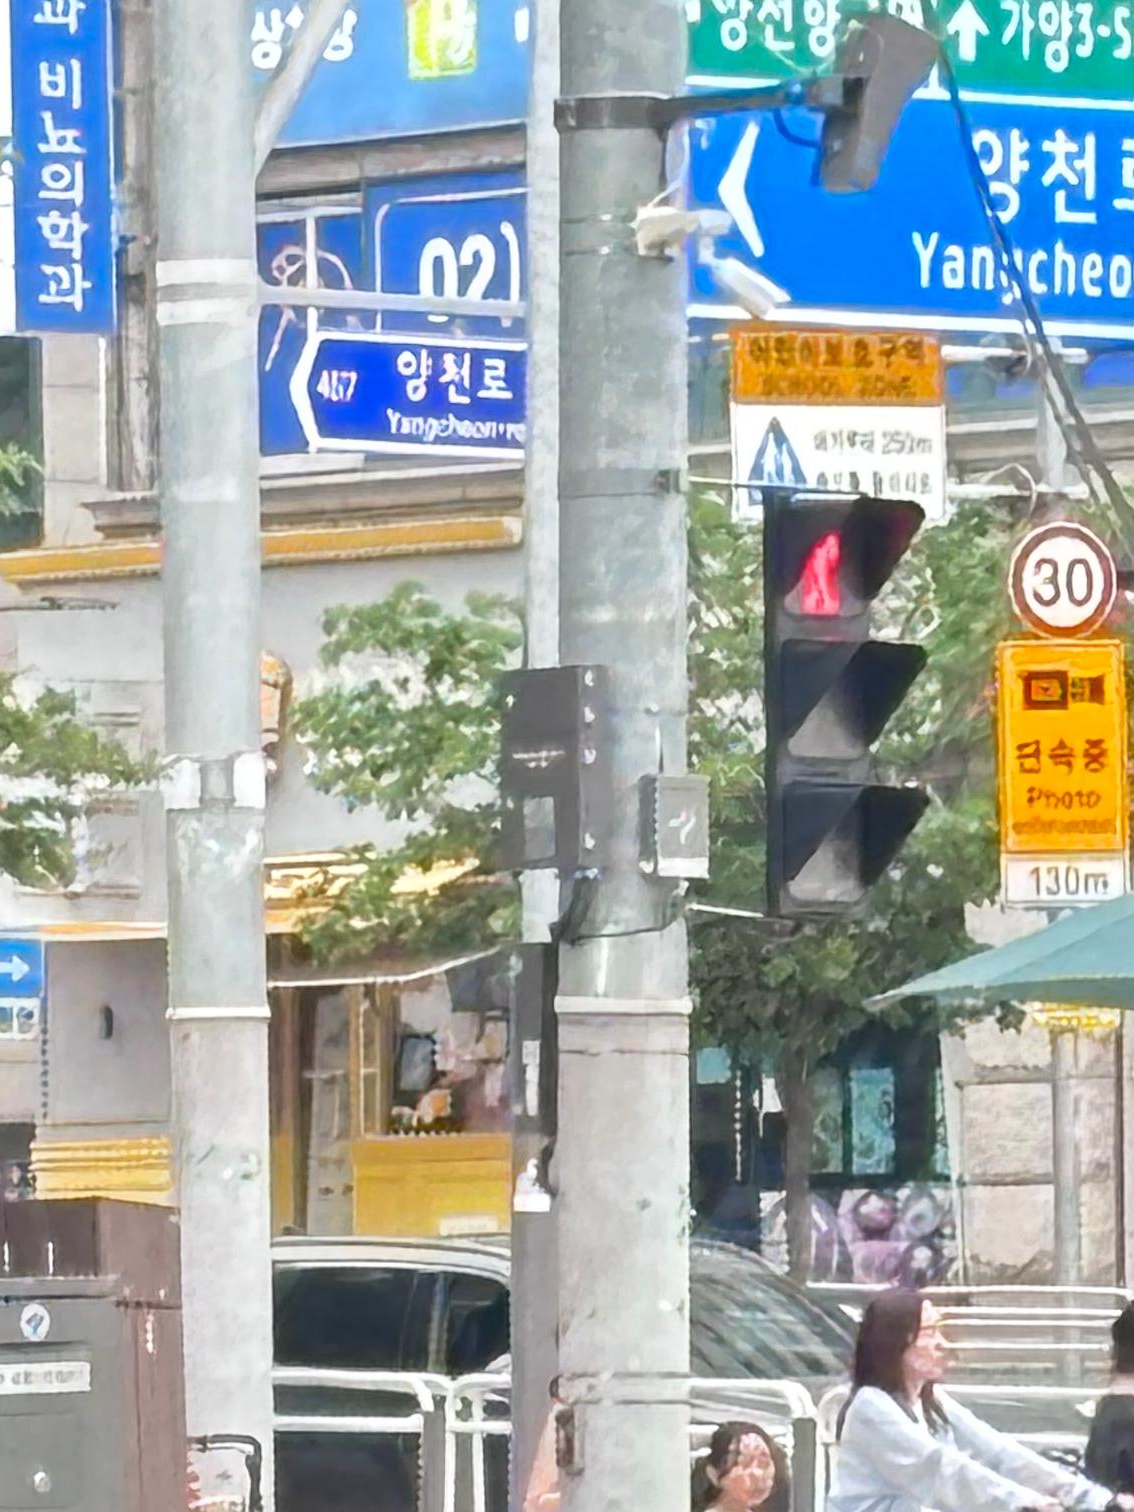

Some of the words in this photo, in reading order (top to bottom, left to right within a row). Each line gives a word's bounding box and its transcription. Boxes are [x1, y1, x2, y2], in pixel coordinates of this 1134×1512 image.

[396, 348, 514, 405] 양천로
[1032, 557, 1094, 607] 30
[1015, 738, 1108, 774] 단속중
[1029, 866, 1109, 898] 130m
